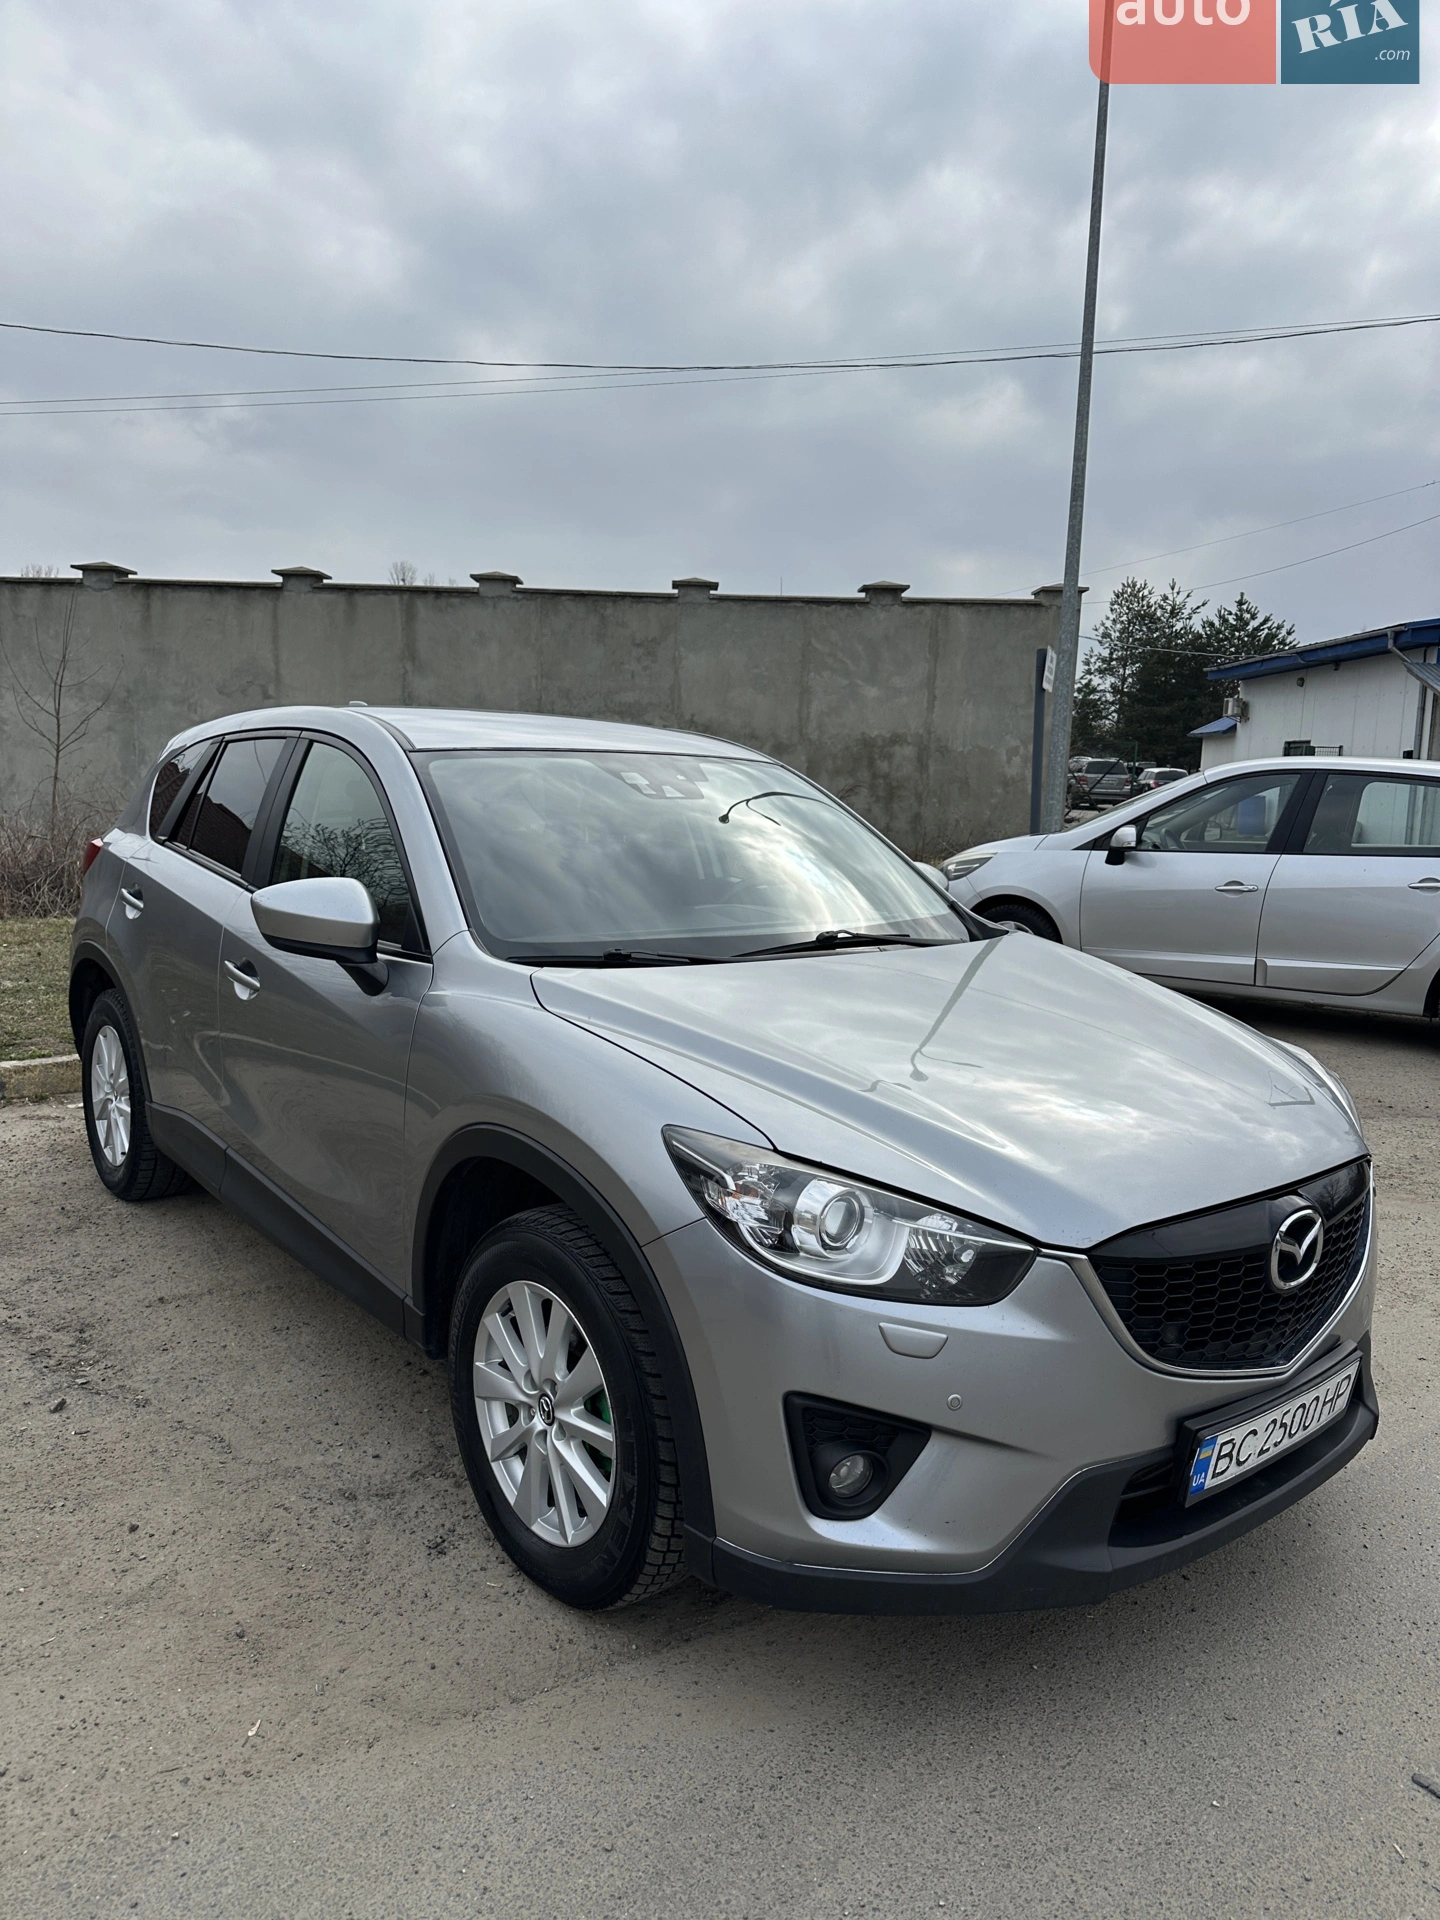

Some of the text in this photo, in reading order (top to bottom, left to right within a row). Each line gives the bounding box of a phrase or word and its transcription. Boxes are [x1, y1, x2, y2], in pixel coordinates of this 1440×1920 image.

[1211, 1373, 1352, 1479] BC 2500 HP
[598, 1392, 638, 1578] NEXEN
[1192, 1473, 1205, 1486] UA
